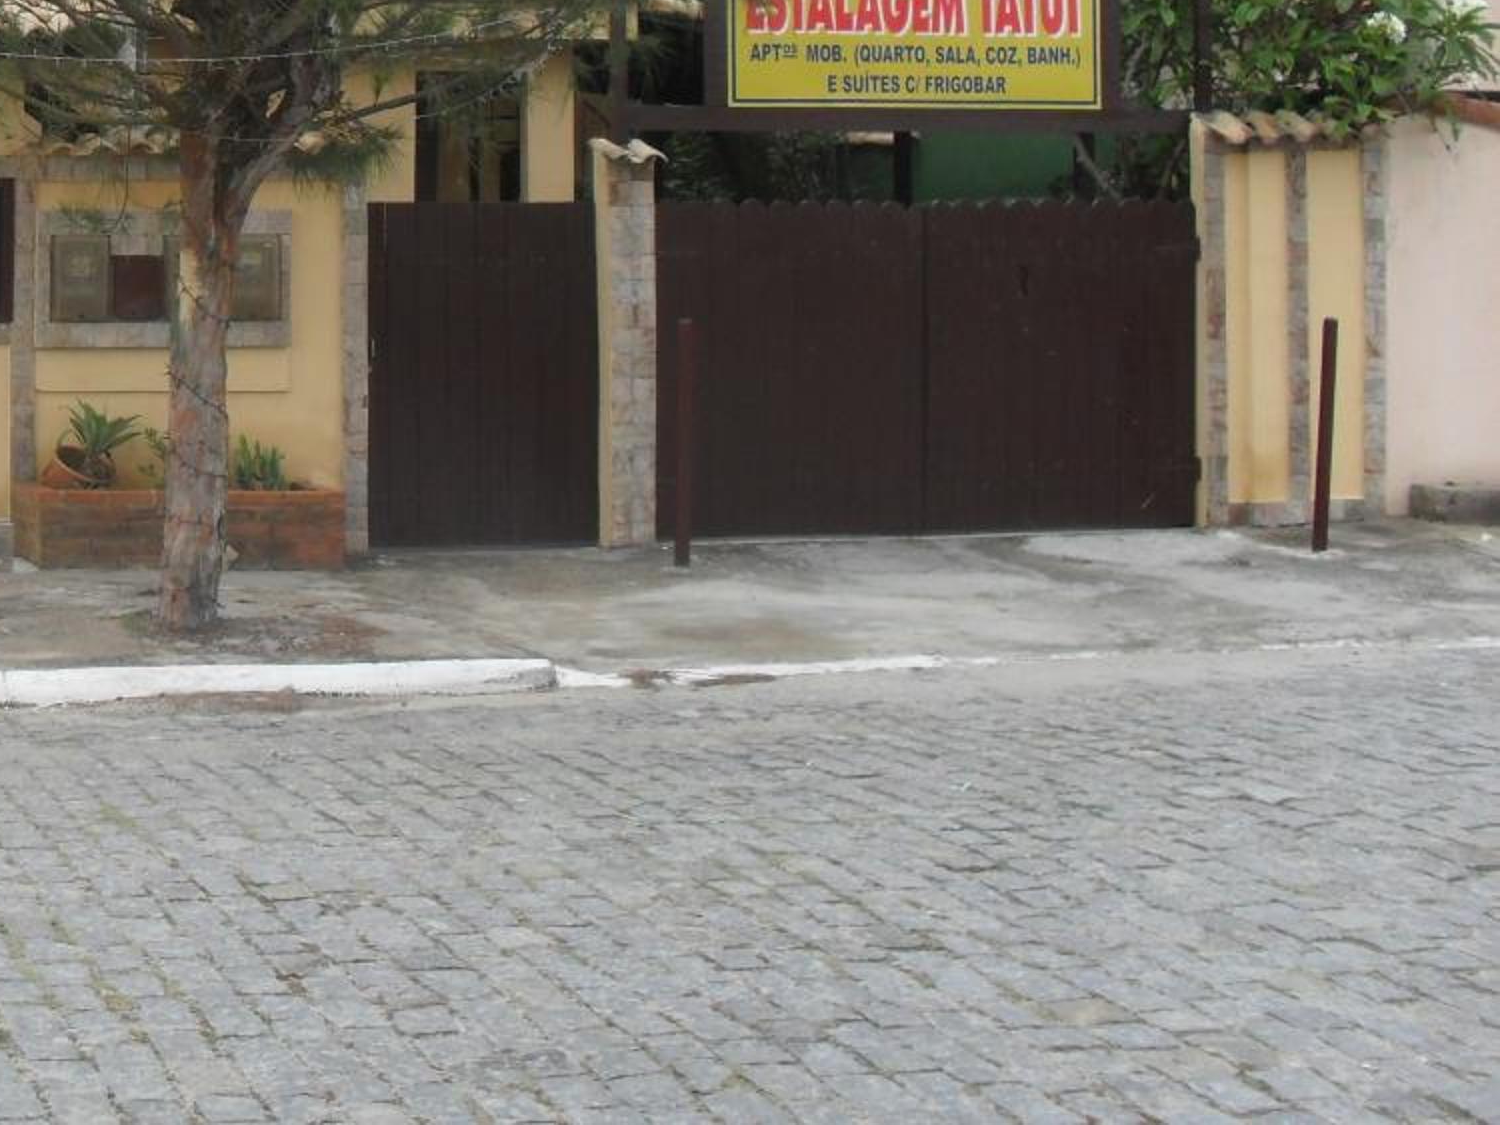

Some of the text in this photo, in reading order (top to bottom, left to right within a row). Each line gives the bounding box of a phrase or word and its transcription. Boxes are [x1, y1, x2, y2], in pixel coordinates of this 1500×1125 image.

[806, 44, 847, 63] MOB.
[854, 44, 931, 68] (QUARTO,
[935, 46, 981, 66] SALA,
[1027, 47, 1081, 70] BANH.)
[827, 75, 837, 93] E
[925, 76, 1006, 94] FRIGOBAR
